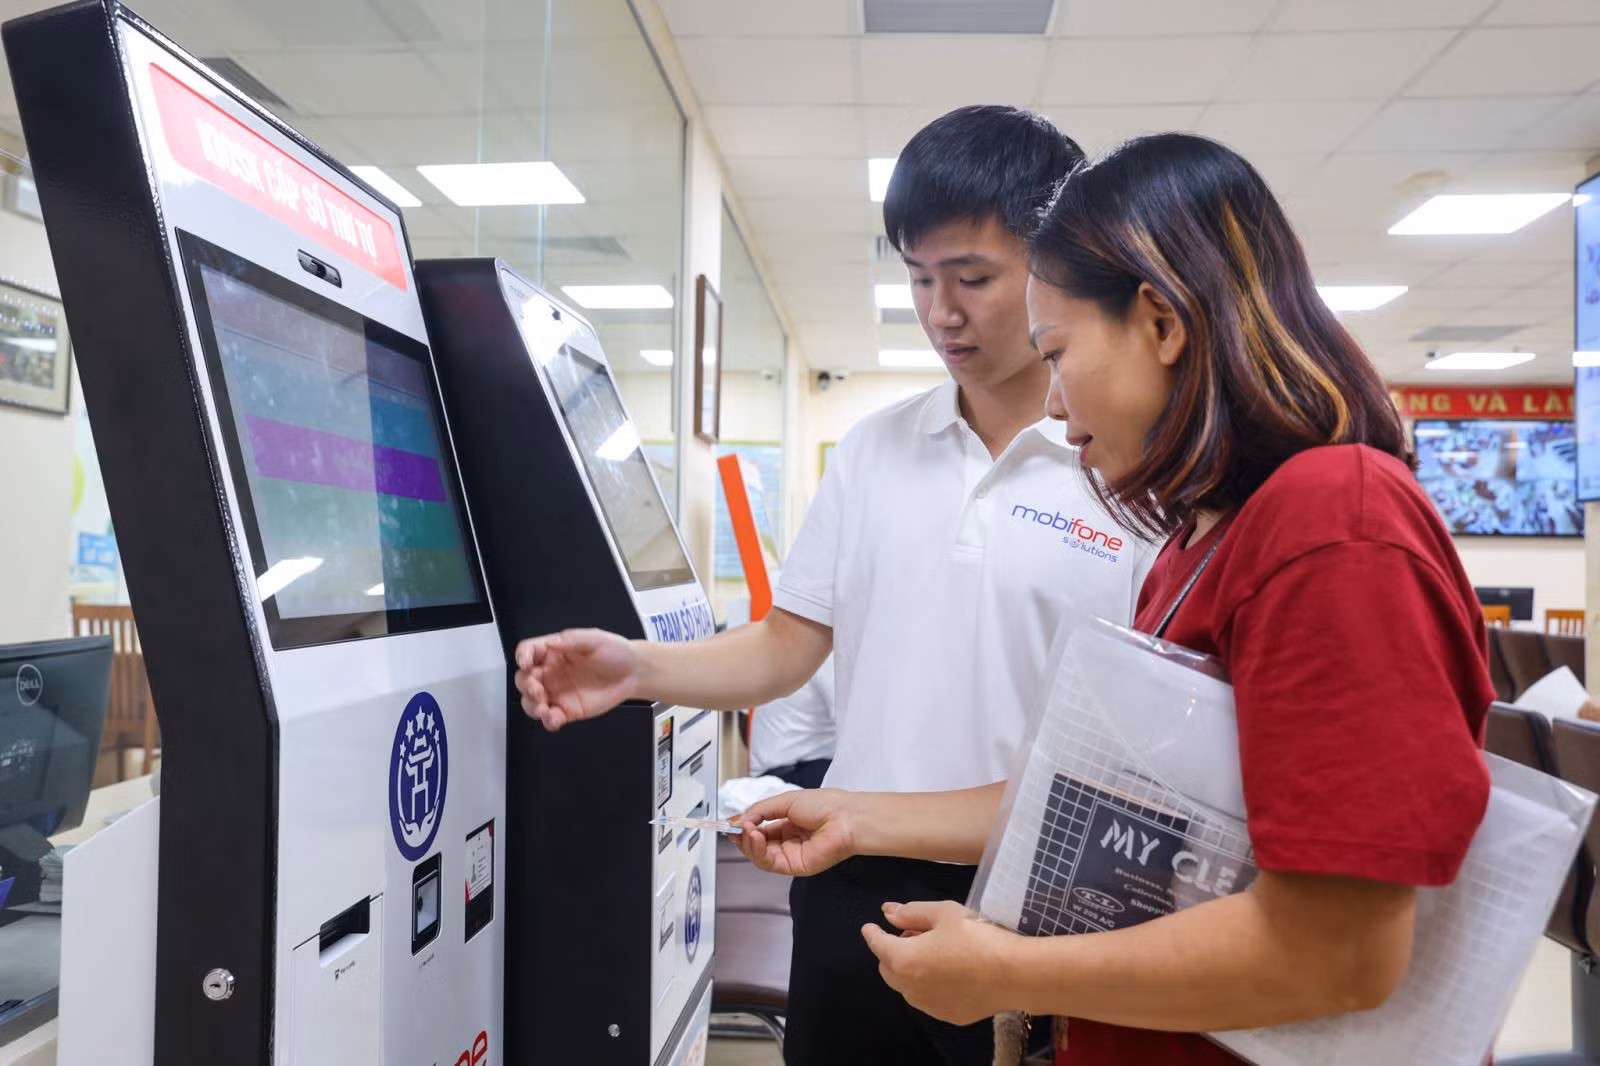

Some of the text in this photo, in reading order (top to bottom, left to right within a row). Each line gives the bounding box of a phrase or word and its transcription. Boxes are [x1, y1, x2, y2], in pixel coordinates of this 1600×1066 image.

[196, 117, 265, 192] KIOSK
[1467, 389, 1508, 413] VÀ
[1012, 505, 1123, 551] mobifone
[1100, 818, 1161, 867] MY
